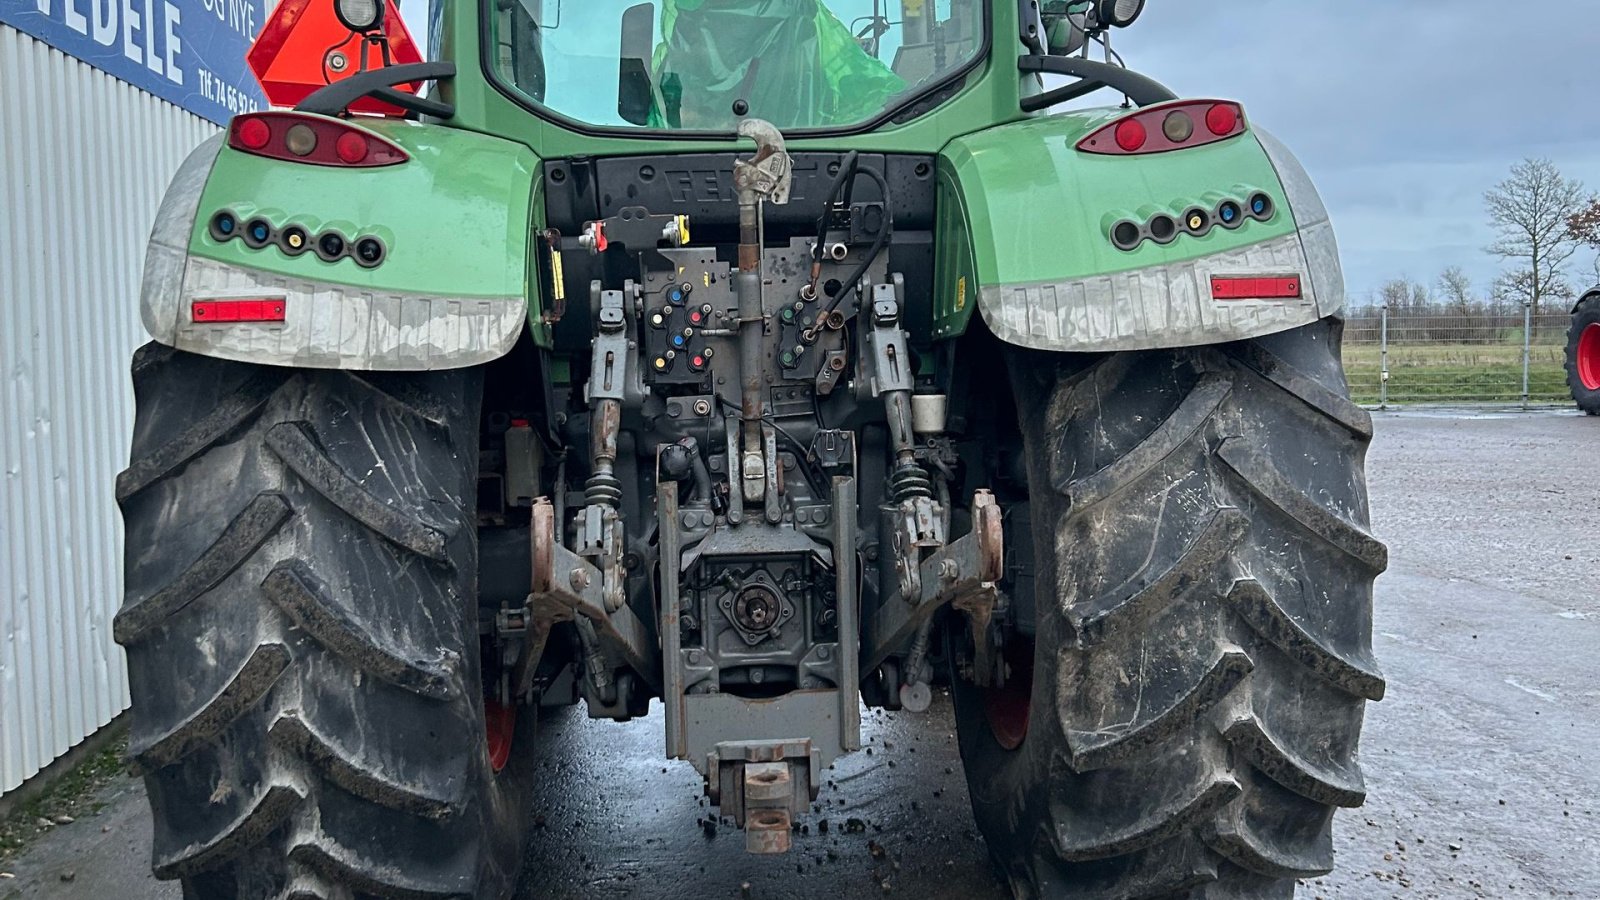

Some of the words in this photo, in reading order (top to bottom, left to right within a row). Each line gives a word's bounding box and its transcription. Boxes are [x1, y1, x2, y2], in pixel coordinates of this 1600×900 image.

[37, 0, 183, 85] DELE
[198, 68, 214, 101] Tlf.
[215, 78, 226, 107] 74
[227, 85, 238, 113] 66
